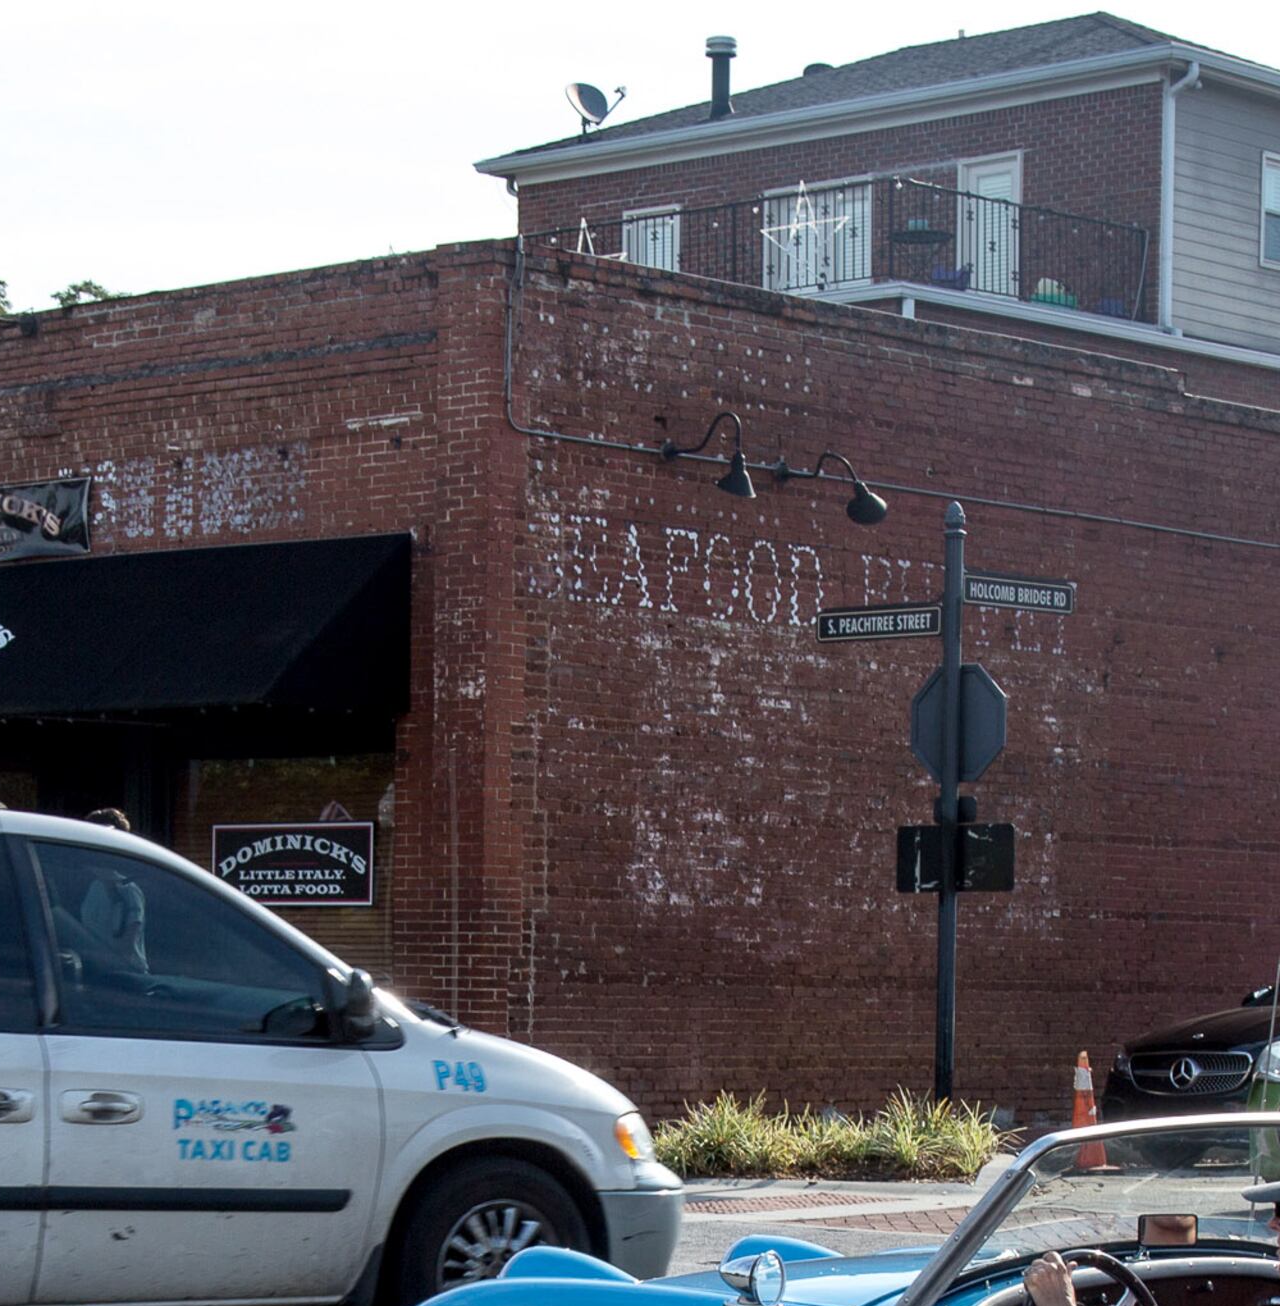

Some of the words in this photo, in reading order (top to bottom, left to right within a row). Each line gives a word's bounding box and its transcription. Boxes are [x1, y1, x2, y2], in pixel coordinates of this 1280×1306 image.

[970, 582, 1016, 601] HOLCOMB
[1018, 587, 1052, 605] BRIDGE
[1054, 591, 1067, 607] RD
[827, 620, 837, 635] S.
[839, 616, 894, 634] PEACHTREE
[897, 613, 932, 630] STREET
[219, 834, 367, 877] DOMINICK'S
[239, 870, 296, 881] LITTLE
[298, 869, 346, 880] ITALY.
[239, 884, 292, 895] LOTTA
[294, 884, 344, 895] FOOD.
[432, 1059, 486, 1093] P49
[177, 1138, 235, 1161] TAXI
[242, 1140, 291, 1162] CAB
